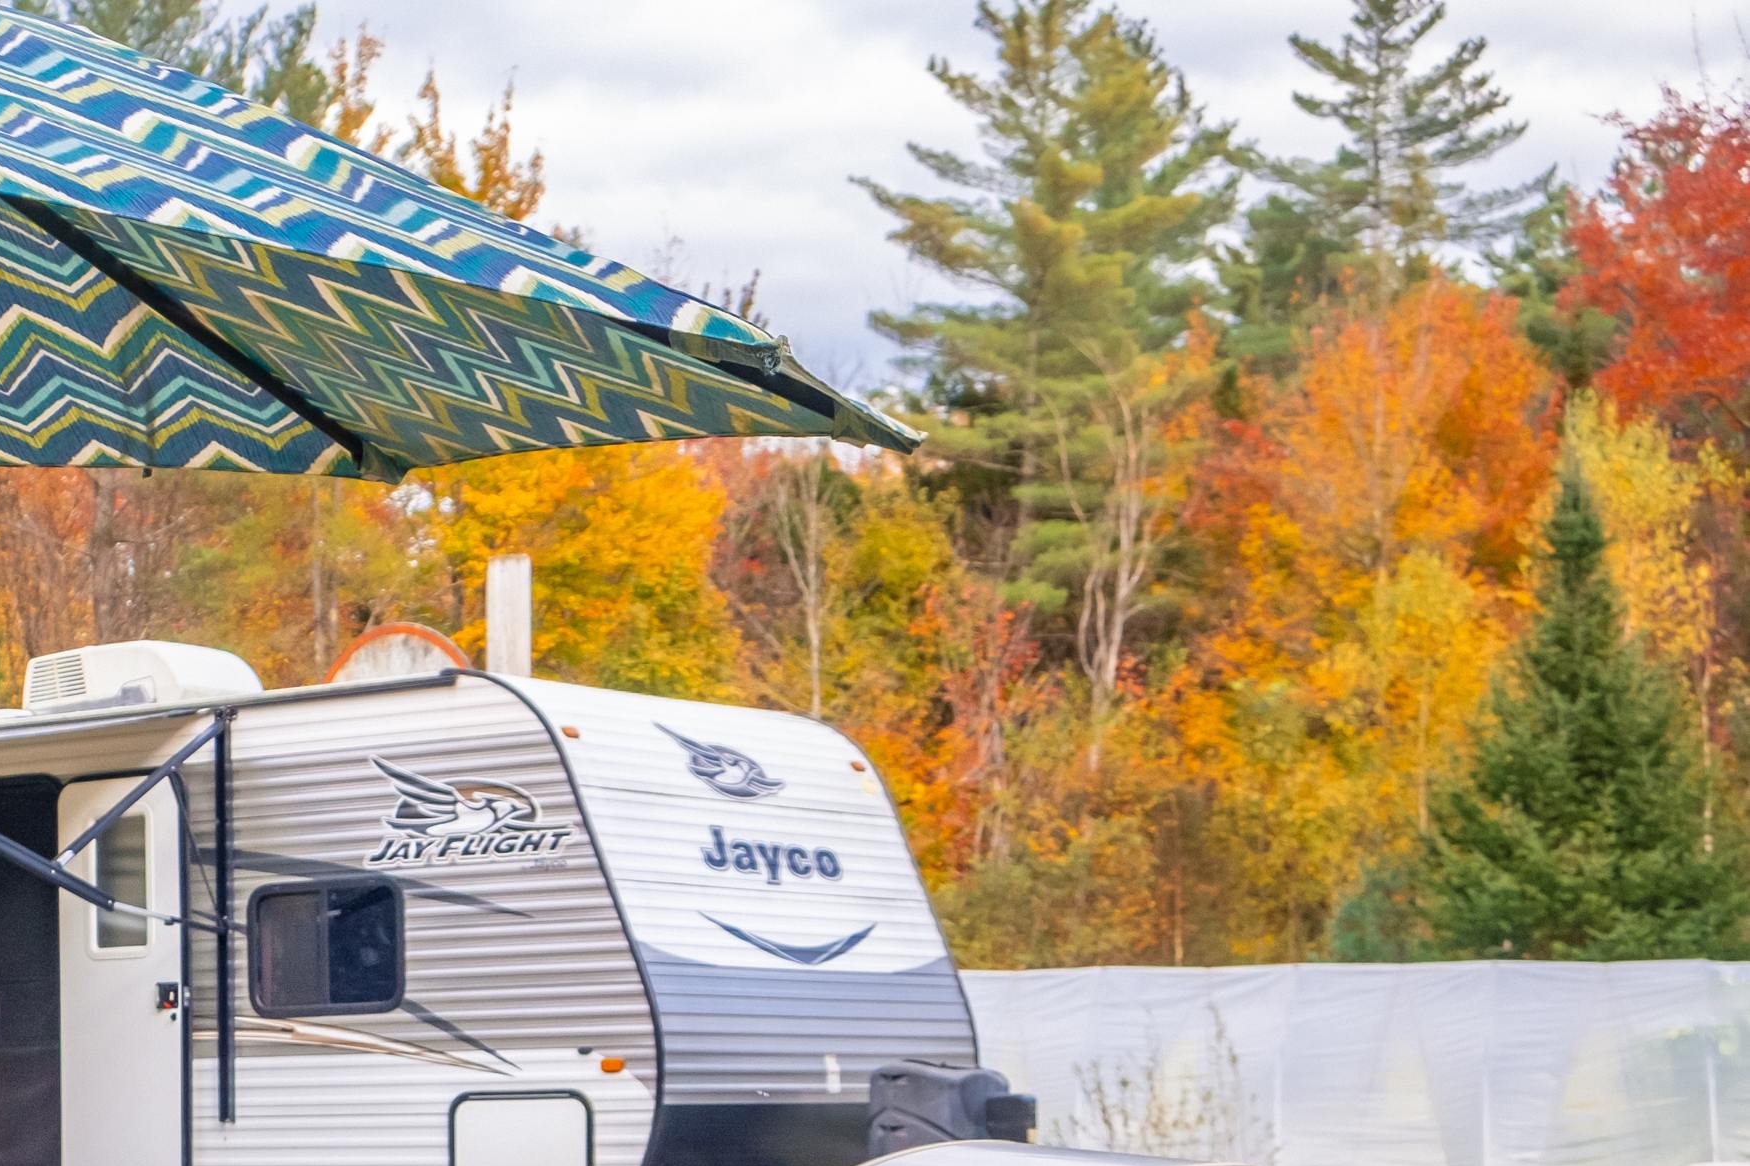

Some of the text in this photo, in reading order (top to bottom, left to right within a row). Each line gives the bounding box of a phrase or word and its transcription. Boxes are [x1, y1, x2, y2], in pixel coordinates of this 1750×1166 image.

[368, 831, 572, 863] JAY FLIGHT
[701, 825, 843, 885] Jayco
